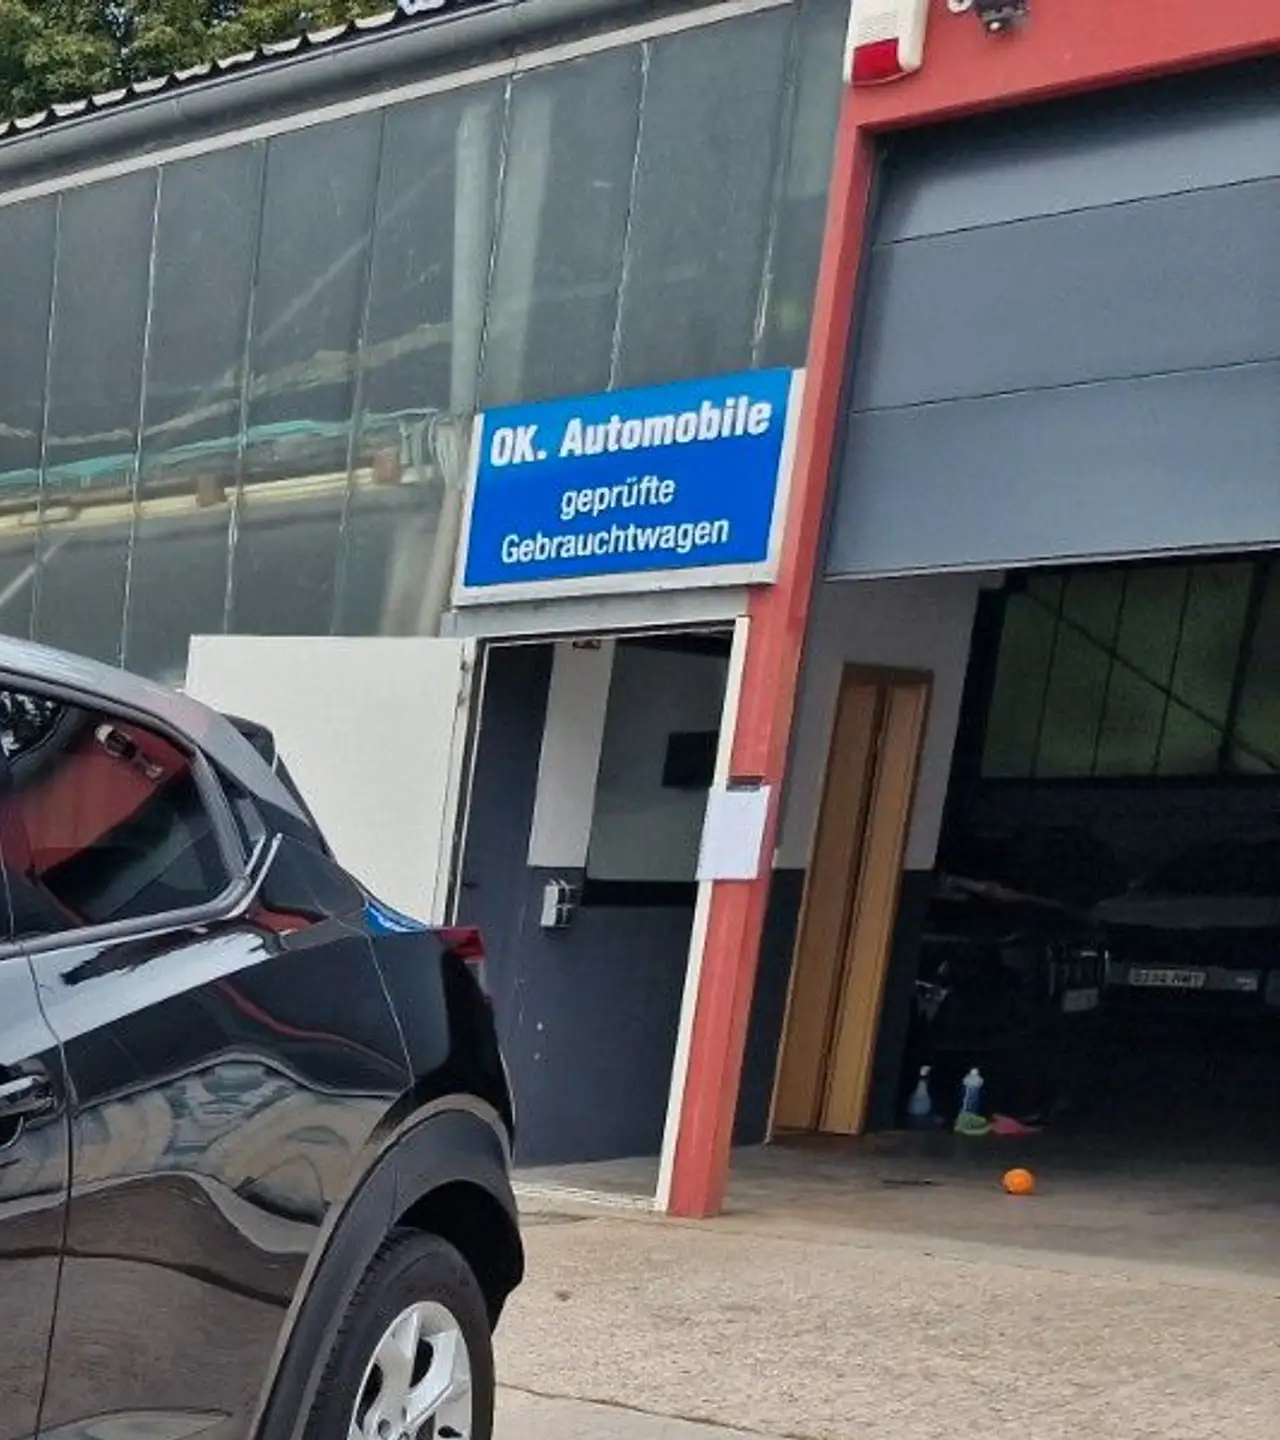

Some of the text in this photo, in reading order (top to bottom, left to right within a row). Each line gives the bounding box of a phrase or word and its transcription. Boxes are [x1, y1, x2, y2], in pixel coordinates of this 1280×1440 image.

[489, 395, 774, 467] OK. Automobile
[560, 475, 677, 521] geprüfte
[501, 518, 731, 564] Gebrauchtwagen
